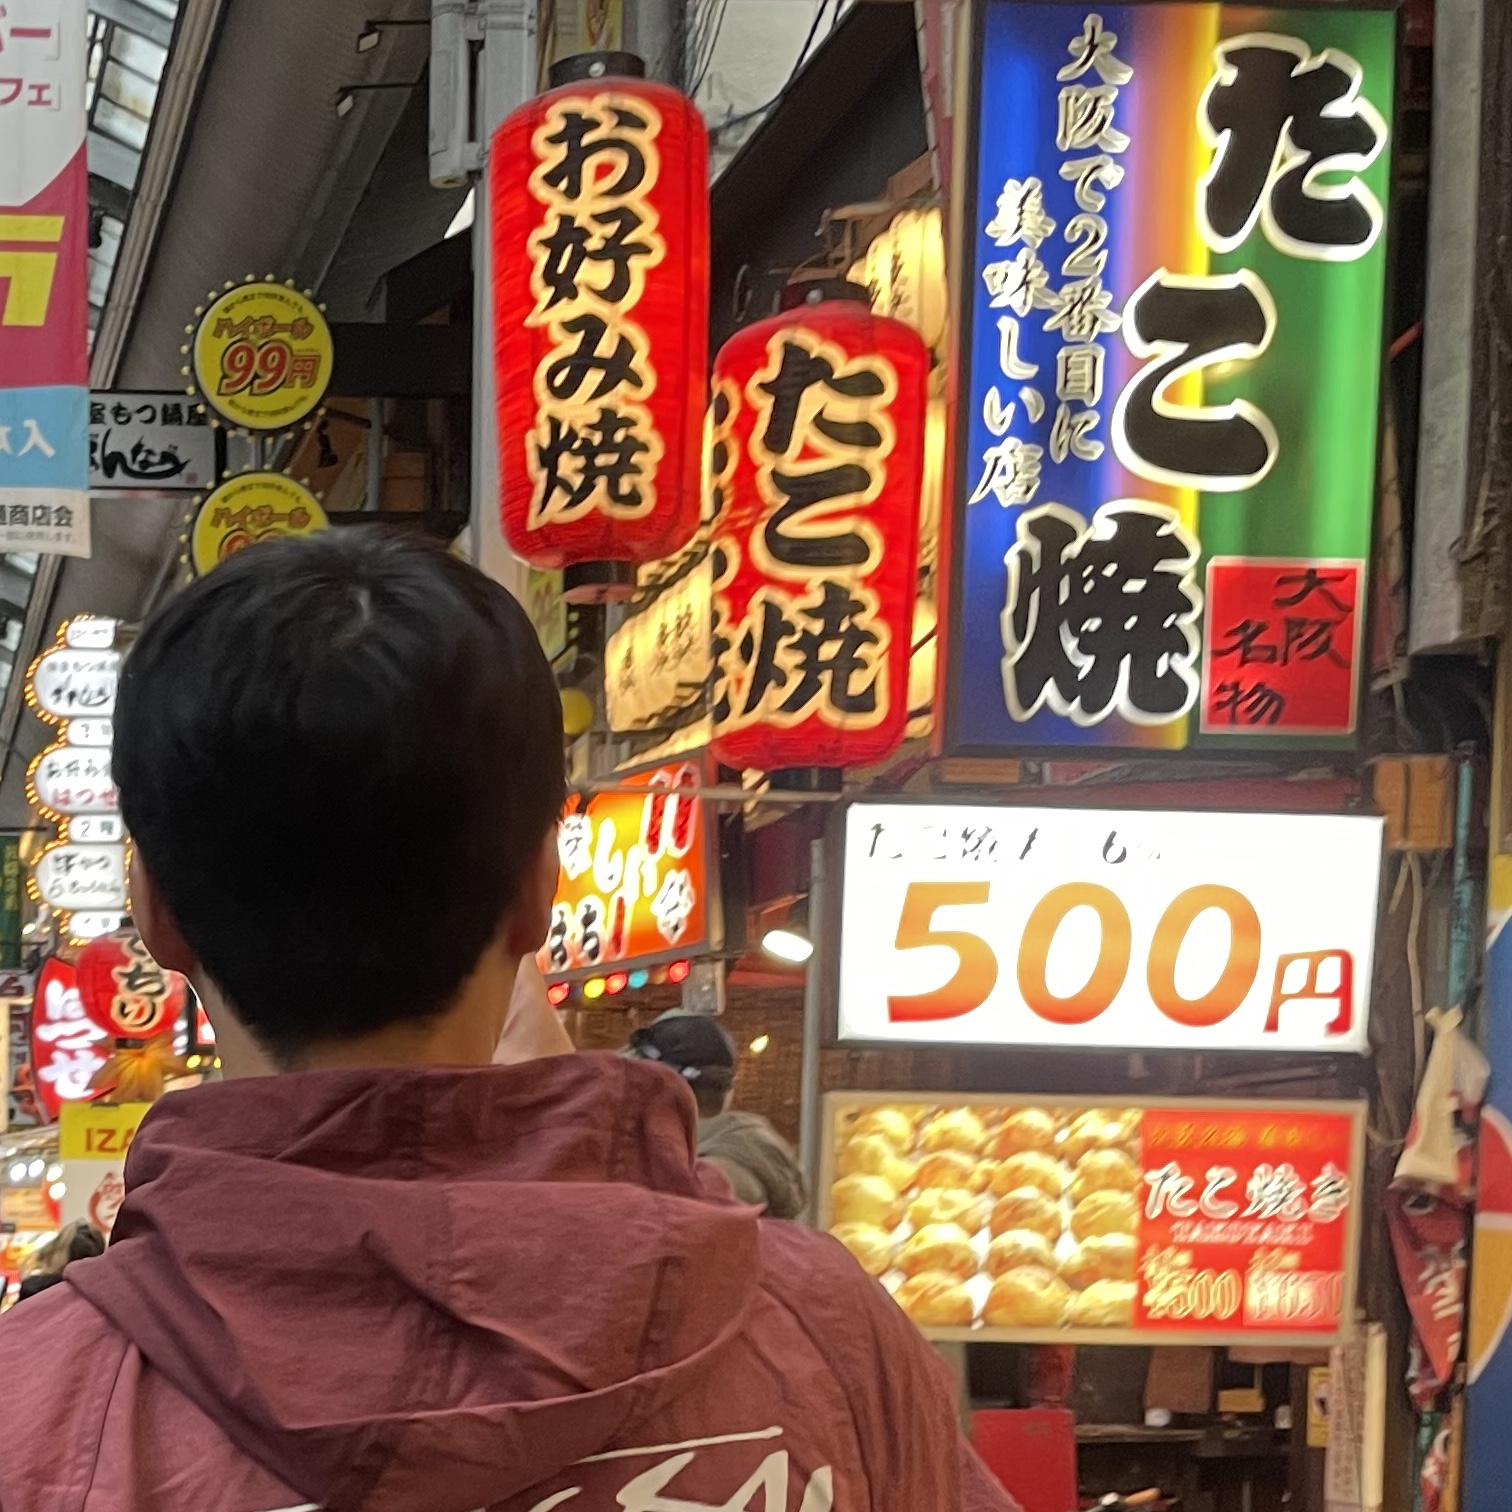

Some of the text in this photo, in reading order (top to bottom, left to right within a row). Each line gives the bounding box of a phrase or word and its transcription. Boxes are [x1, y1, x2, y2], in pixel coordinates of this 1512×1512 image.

[531, 98, 660, 524] お好み焼
[968, 178, 1056, 507] 美味しい店
[1002, 32, 1388, 726] たこ焼
[1043, 13, 1134, 463] 大阪で2番目に
[753, 332, 893, 722] たこ焼
[1210, 618, 1285, 727] 名物
[1272, 567, 1355, 671] 大阪
[887, 881, 1355, 1037] 500円
[1143, 1161, 1351, 1224] たこ焼き
